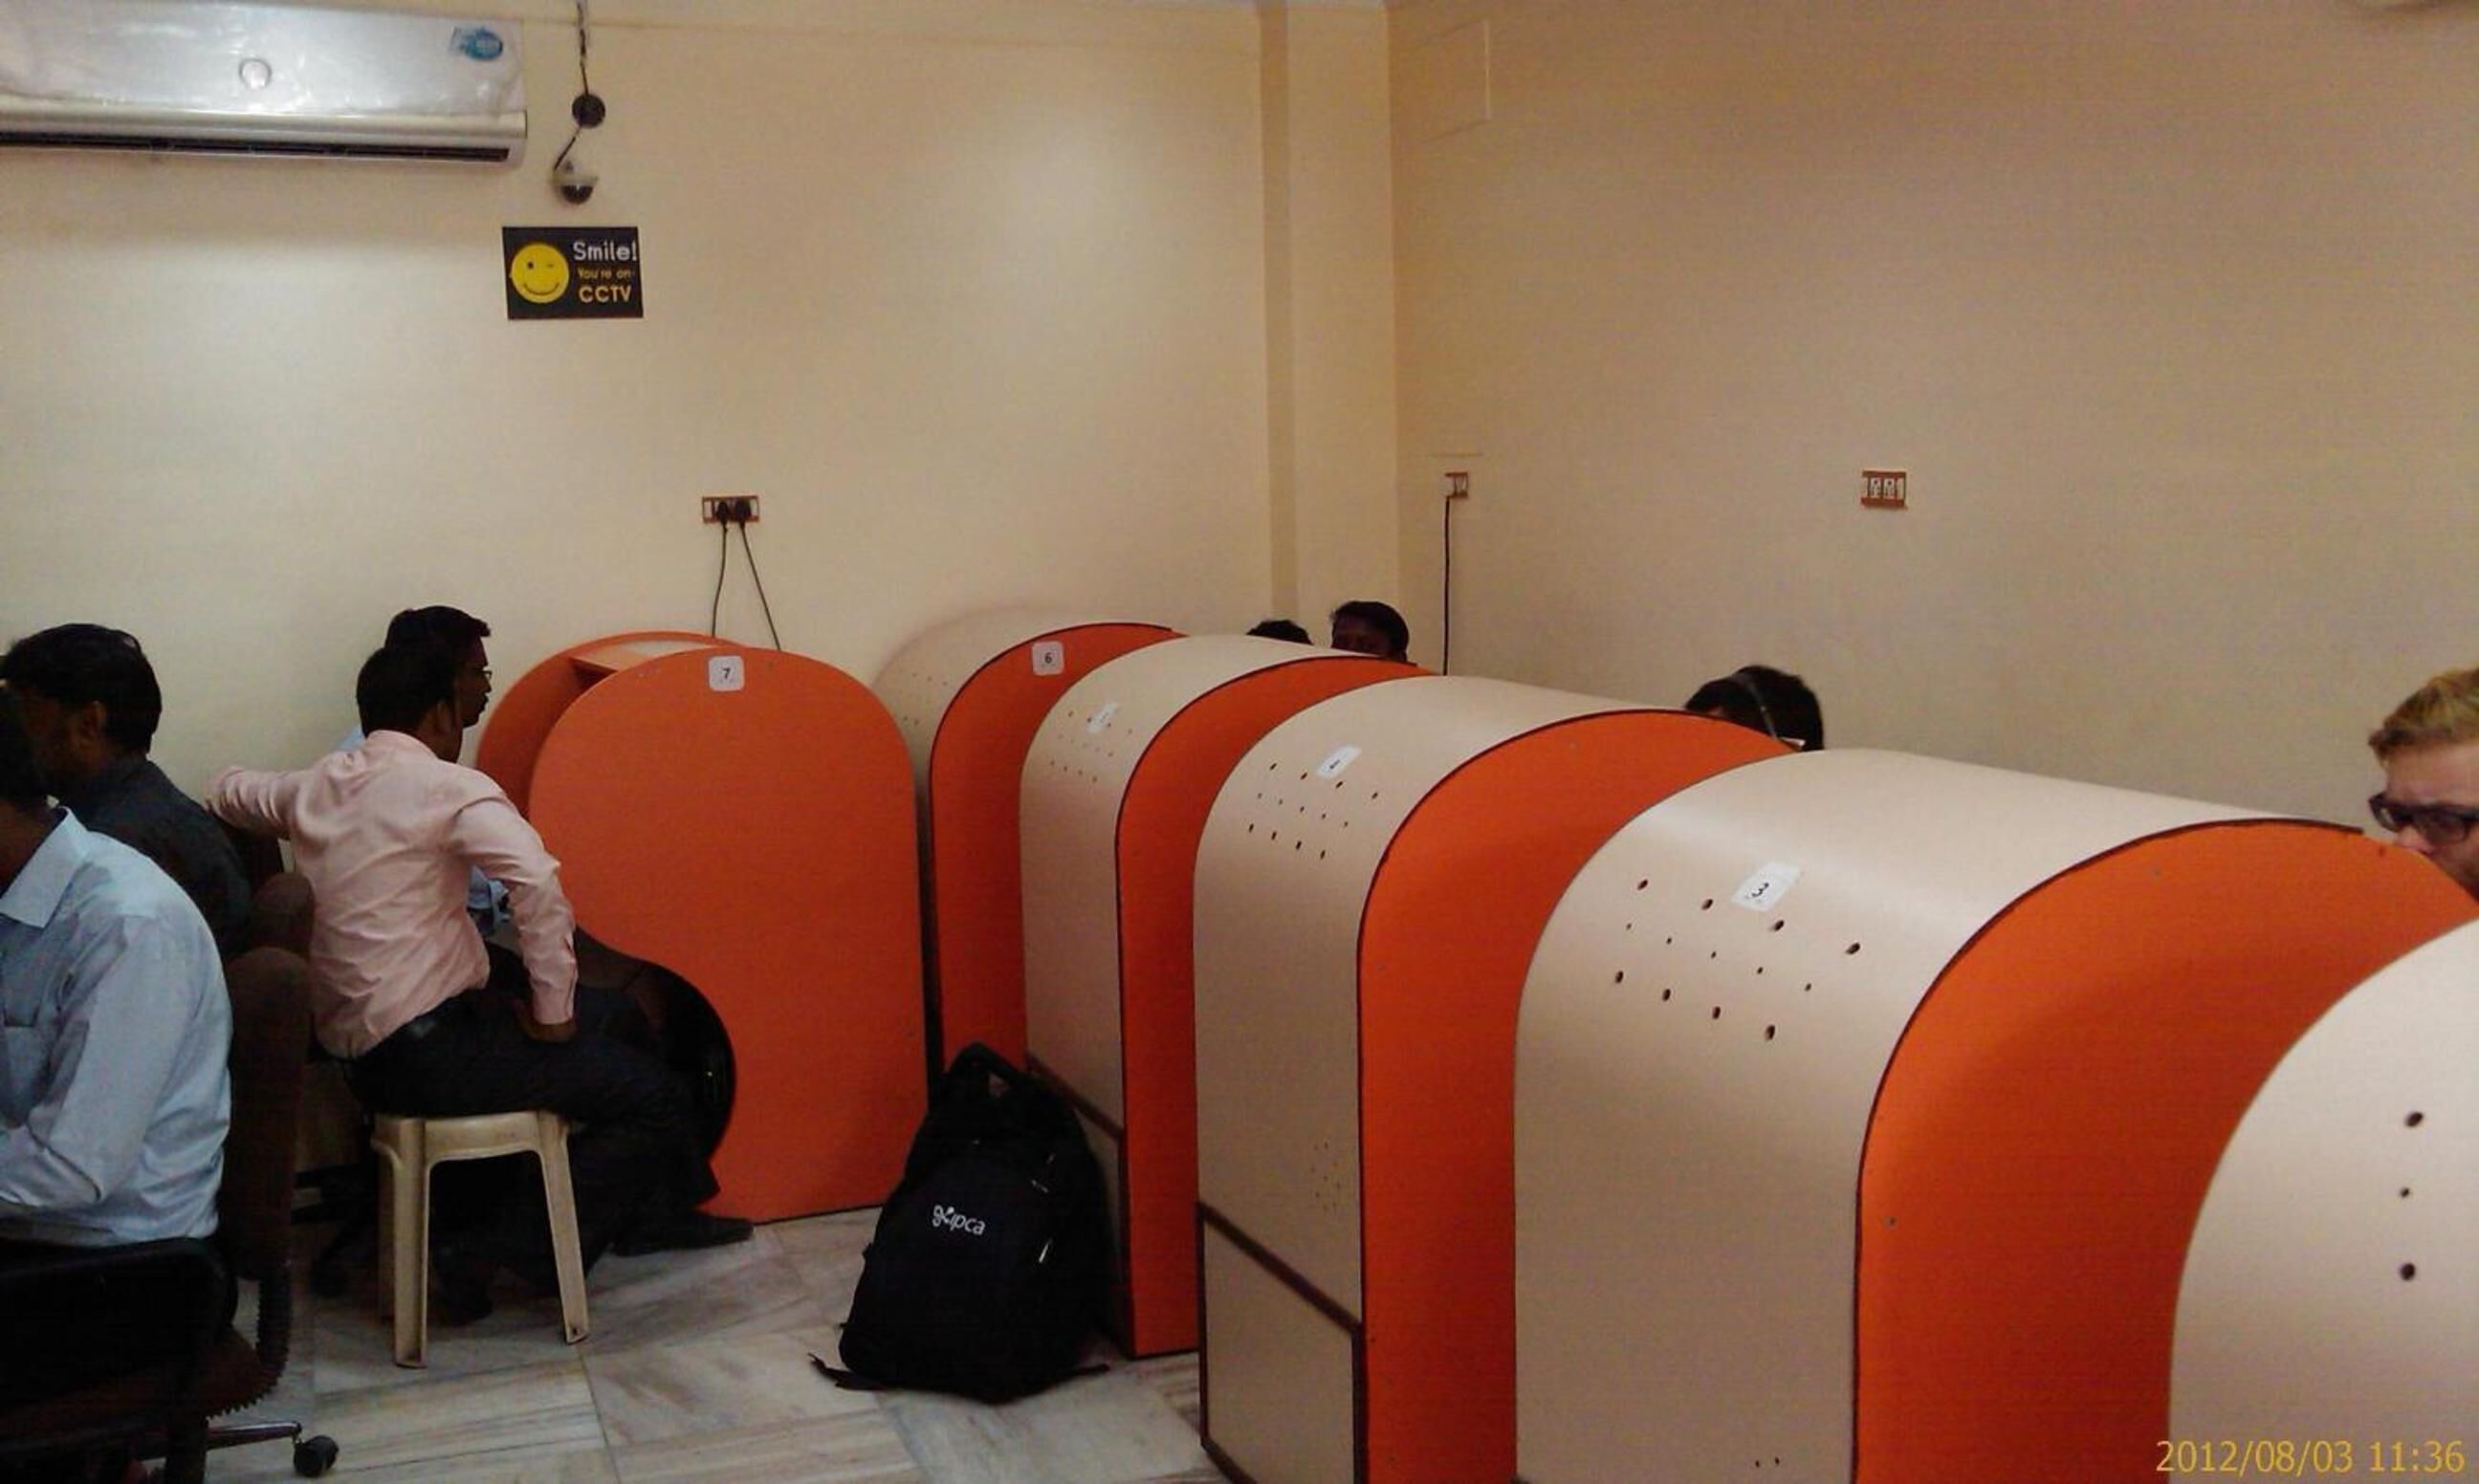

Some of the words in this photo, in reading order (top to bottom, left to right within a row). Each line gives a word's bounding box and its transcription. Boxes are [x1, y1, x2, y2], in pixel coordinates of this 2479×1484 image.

[573, 240, 638, 261] Smile!
[578, 266, 612, 279] You're
[579, 286, 631, 303] CCTV
[1044, 652, 1053, 664] 6
[721, 667, 731, 679] 7
